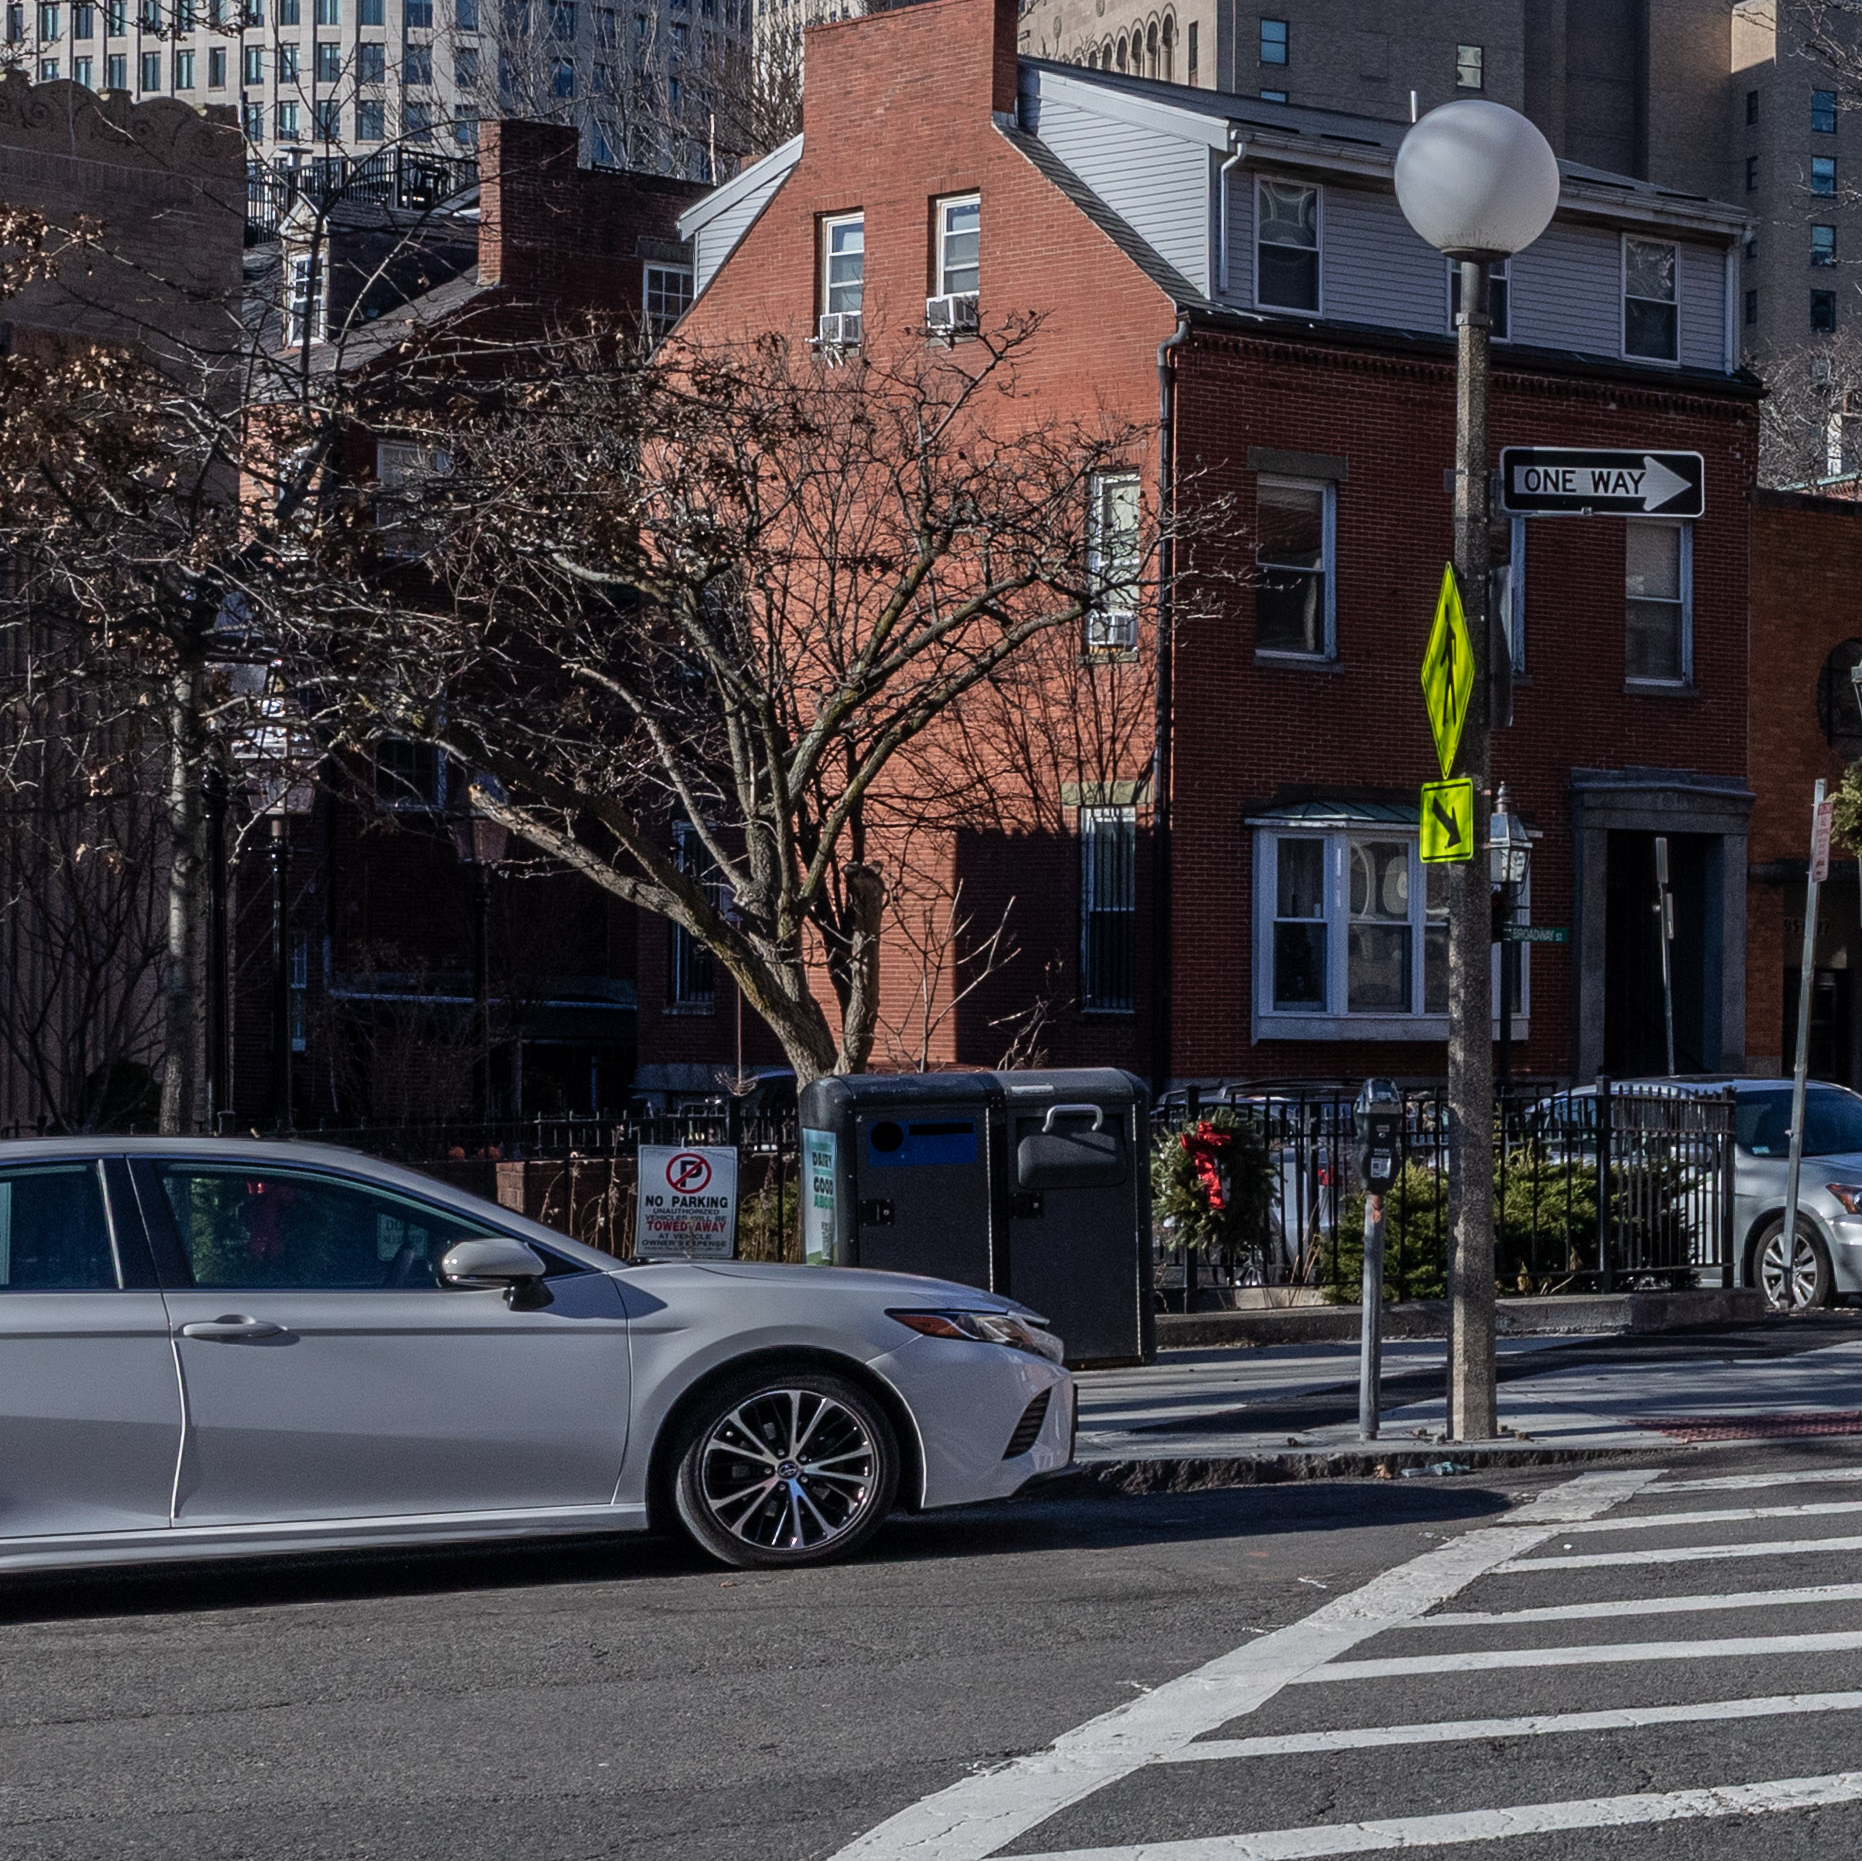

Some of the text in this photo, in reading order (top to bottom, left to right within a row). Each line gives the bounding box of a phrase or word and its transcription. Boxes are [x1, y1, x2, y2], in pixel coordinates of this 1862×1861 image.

[1524, 468, 1646, 495] ONE WAY
[812, 1151, 832, 1168] DAIRY
[813, 1176, 834, 1196] GOOD
[645, 1195, 728, 1209] NO PARKING
[647, 1220, 726, 1233] TOWED AWAY
